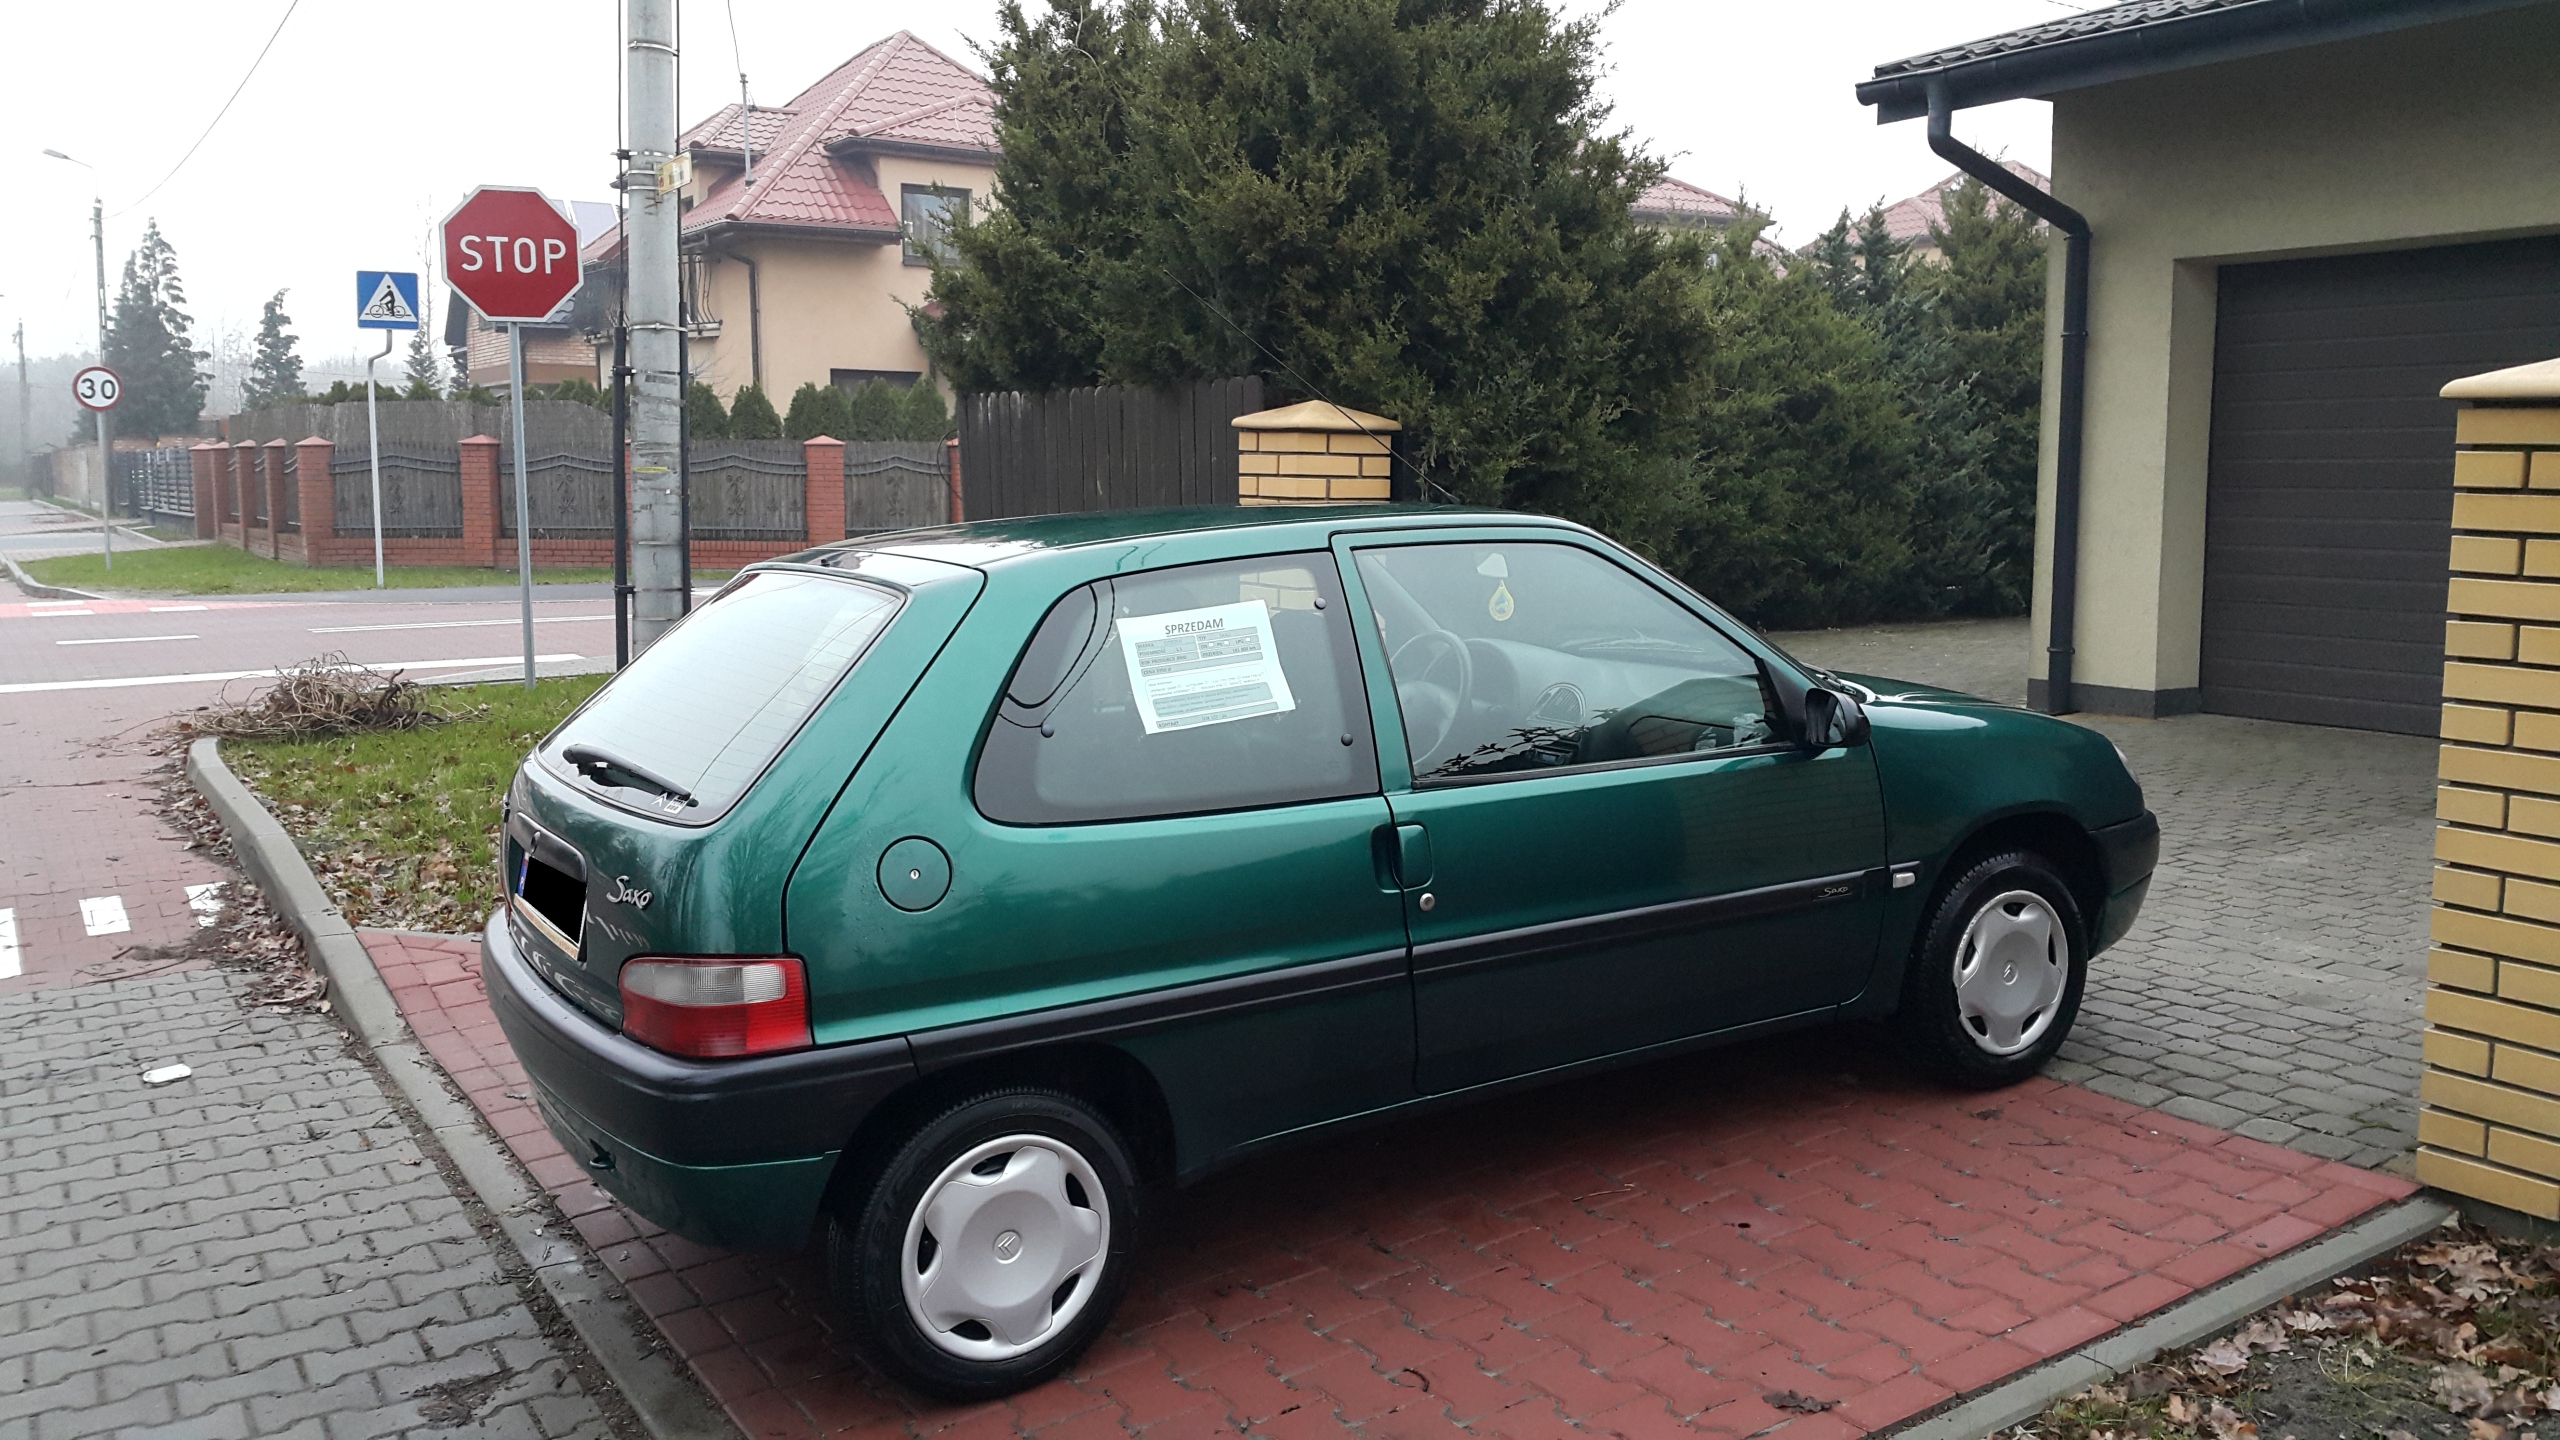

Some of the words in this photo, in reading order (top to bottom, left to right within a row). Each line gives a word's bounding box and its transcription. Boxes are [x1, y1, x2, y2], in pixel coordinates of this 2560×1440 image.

[460, 235, 566, 274] STOP
[81, 378, 116, 400] 30
[1165, 618, 1224, 635] SPRZEDAM
[606, 875, 653, 909] Saxo
[1818, 886, 1849, 898] Saxo
